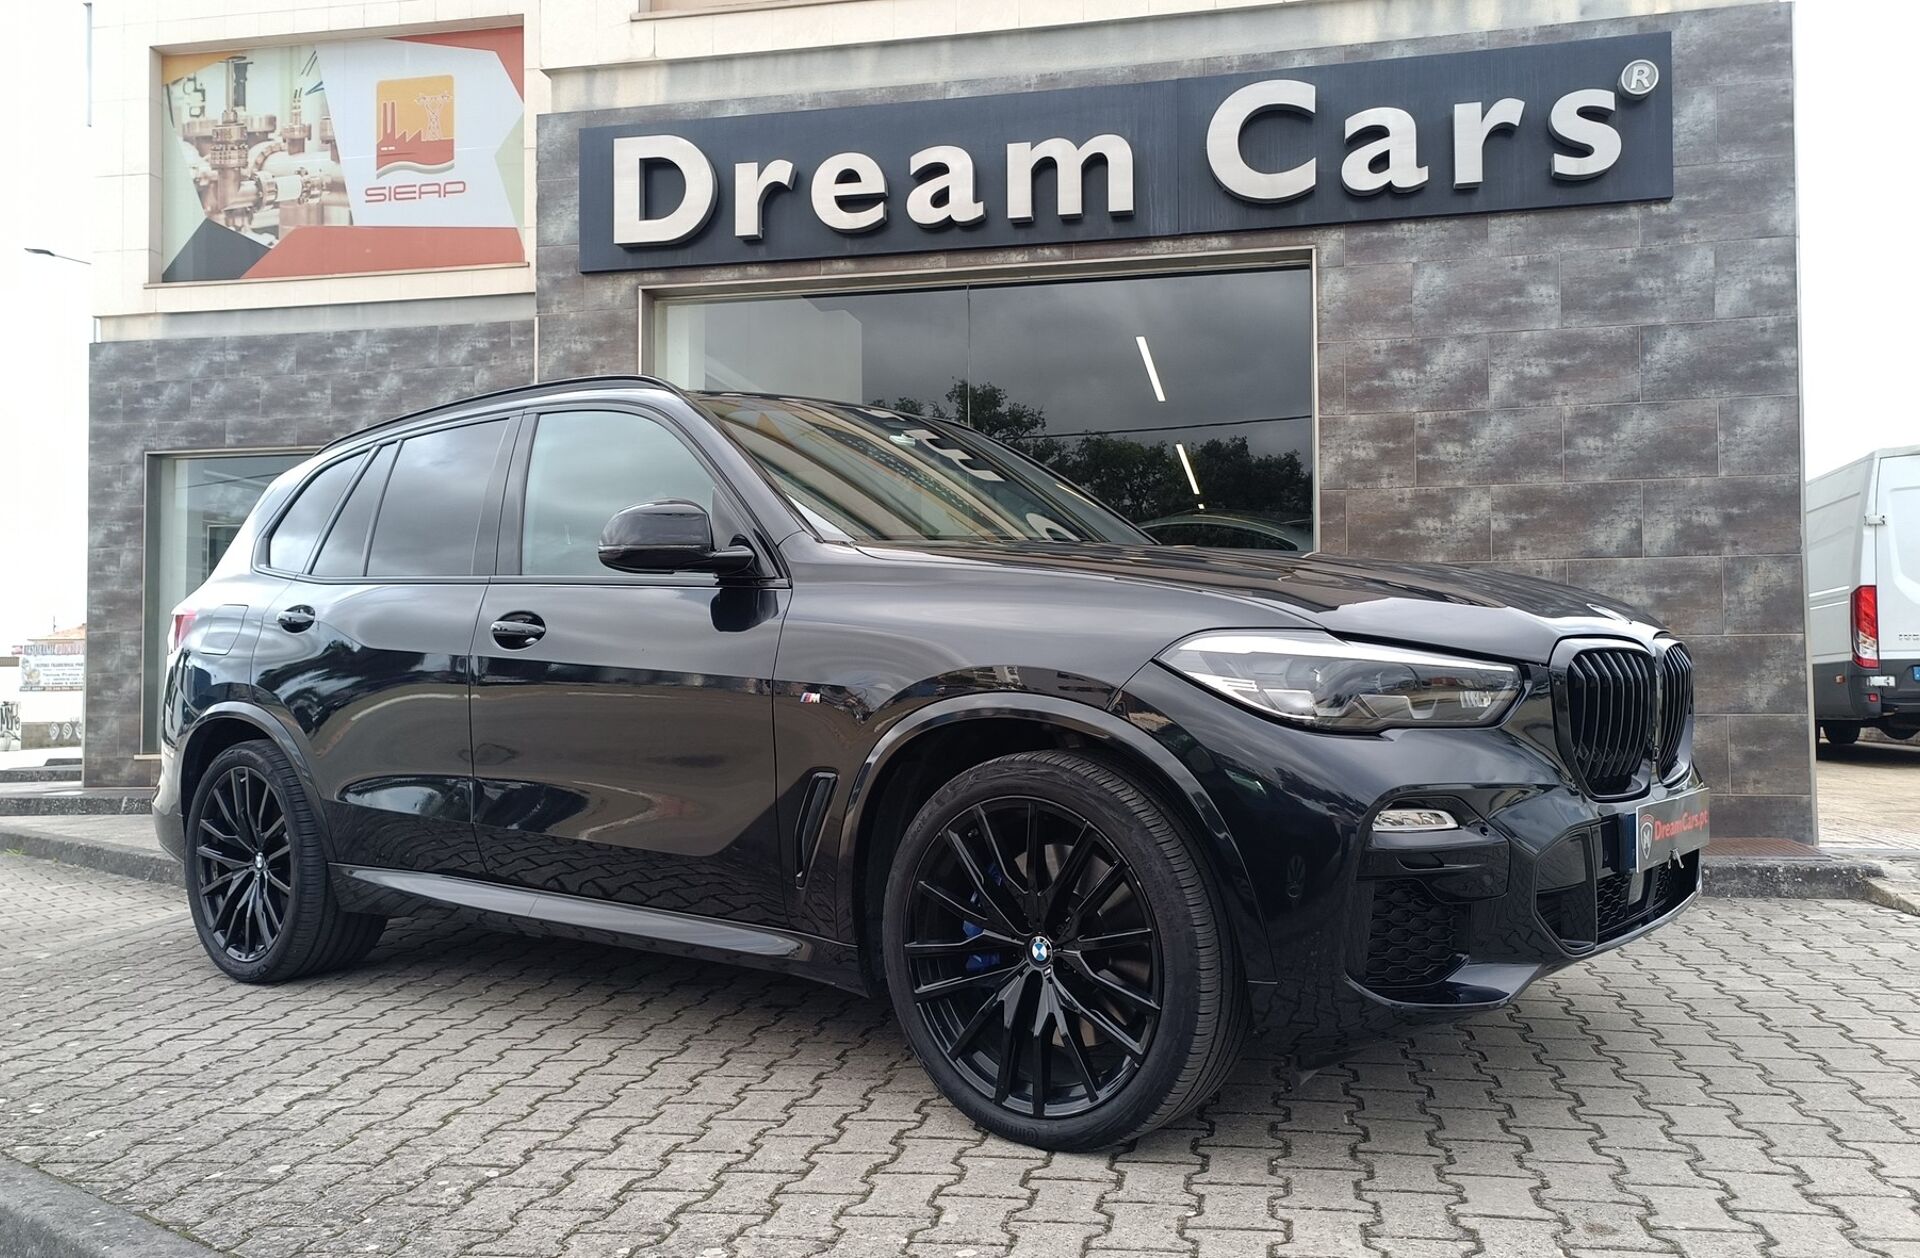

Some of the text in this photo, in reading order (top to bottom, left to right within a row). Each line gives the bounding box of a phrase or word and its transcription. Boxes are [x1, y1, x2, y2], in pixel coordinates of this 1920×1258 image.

[364, 181, 466, 203] SIEAP
[613, 133, 1135, 247] Dream
[1654, 809, 1708, 840] DreamCars.pt
